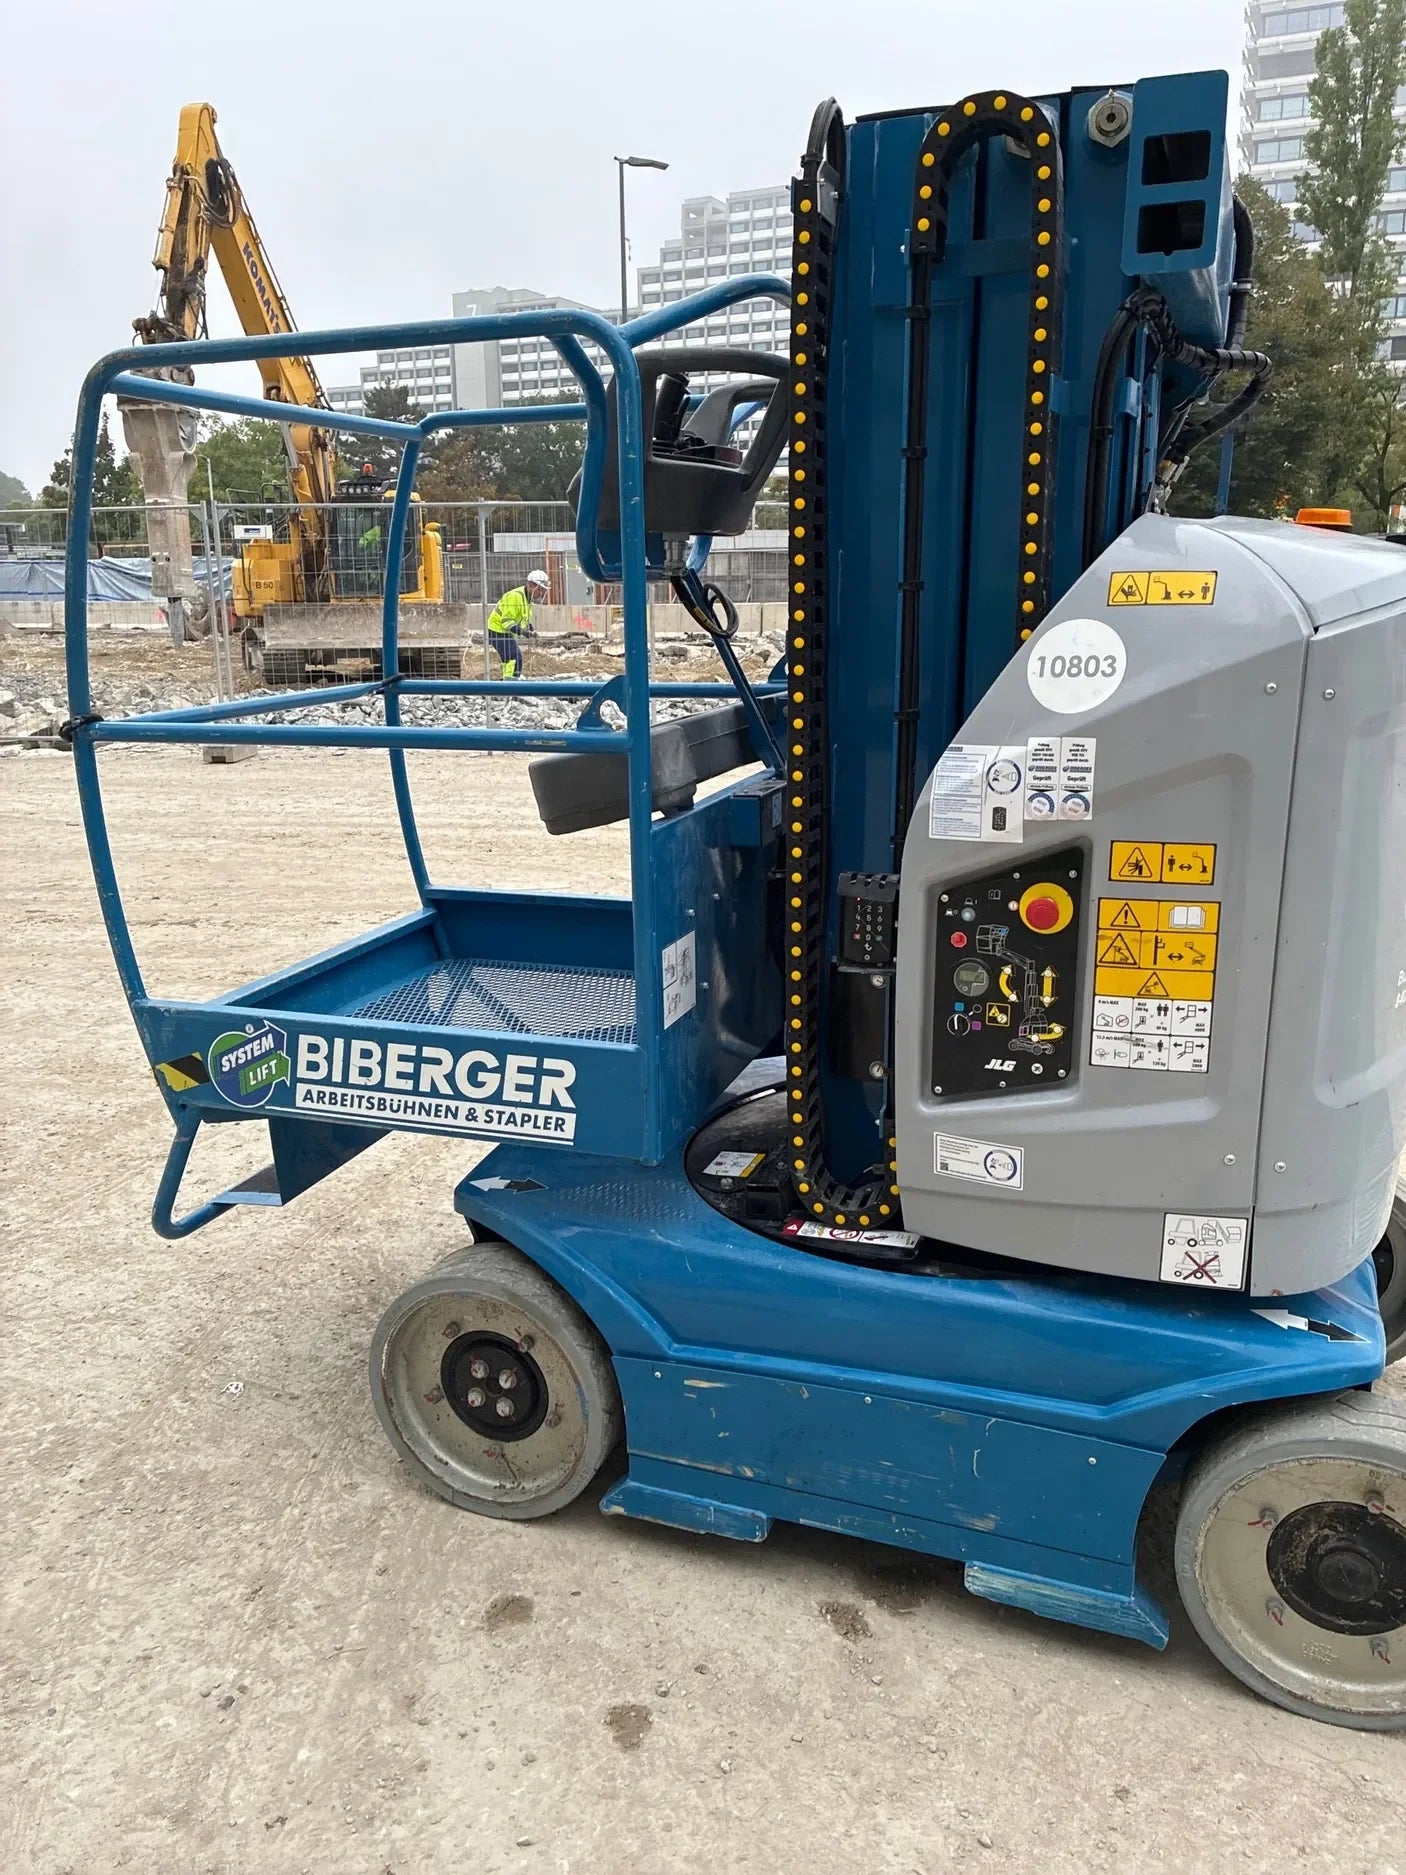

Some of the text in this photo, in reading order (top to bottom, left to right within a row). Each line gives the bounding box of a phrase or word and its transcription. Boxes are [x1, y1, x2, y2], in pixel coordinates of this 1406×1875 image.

[243, 242, 280, 333] KOMATS
[1037, 655, 1117, 678] 10803
[222, 1033, 274, 1072] SYSTEM
[297, 1034, 576, 1108] BIBERGER
[984, 1058, 1016, 1072] JLG
[249, 1059, 277, 1086] LIFT
[302, 1089, 566, 1132] ARBEITSBÜHNEN & STAPLER
